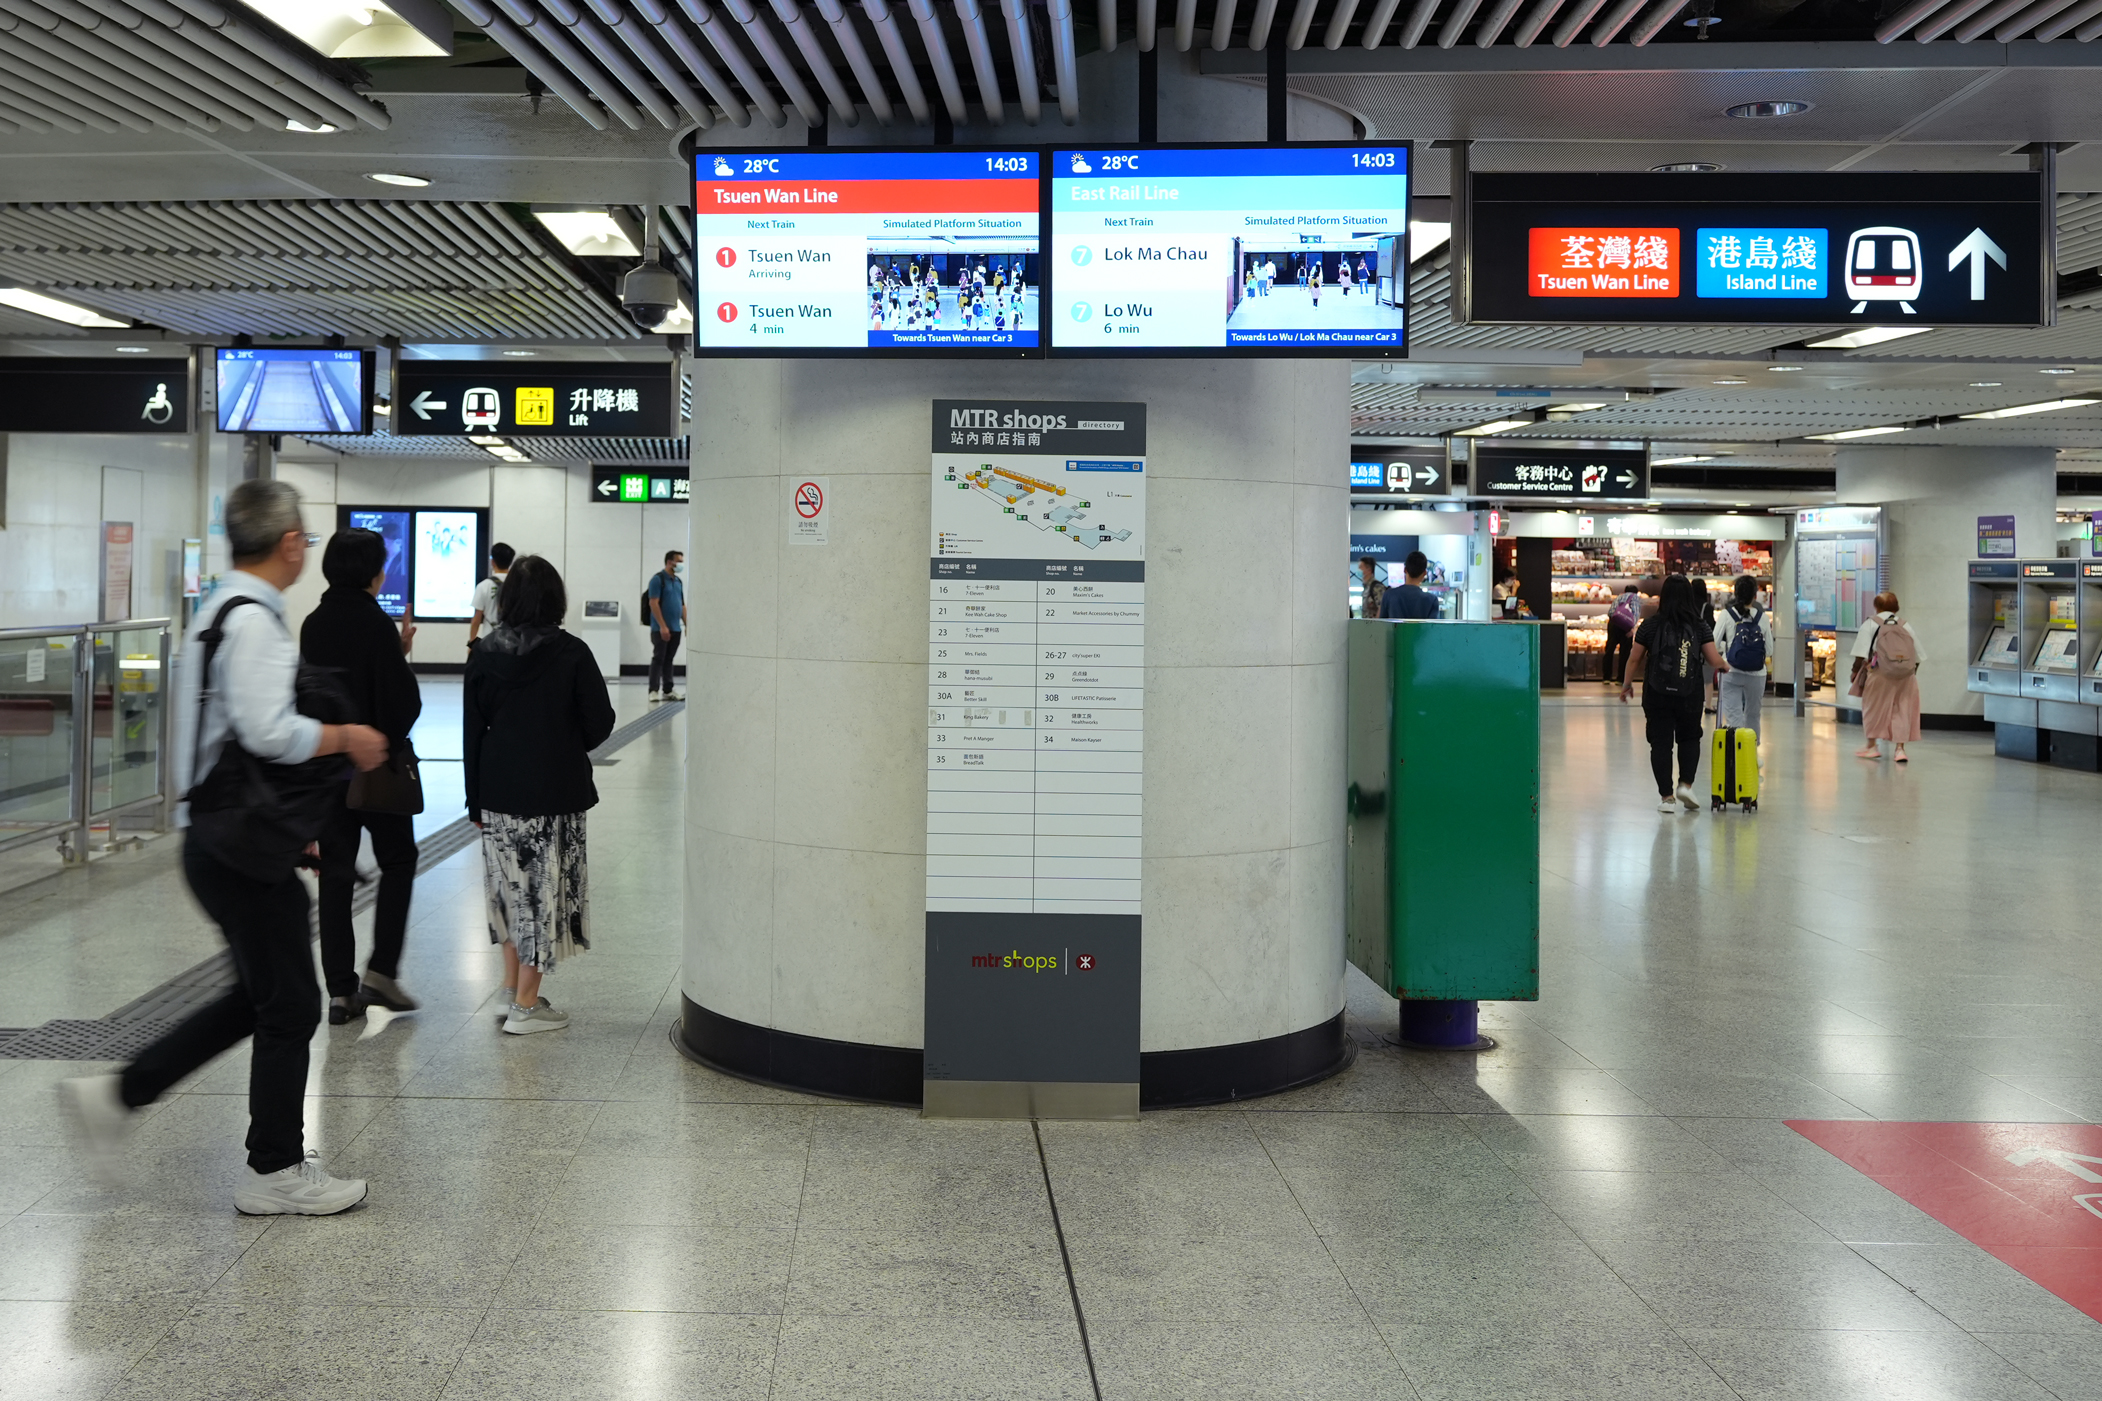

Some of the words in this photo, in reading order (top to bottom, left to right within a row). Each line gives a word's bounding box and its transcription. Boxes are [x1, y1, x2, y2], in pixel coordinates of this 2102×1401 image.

[743, 158, 779, 173] 28°C
[985, 157, 1028, 172] 14:03
[1101, 155, 1139, 170] 28°C
[1351, 153, 1395, 168] 14:03
[714, 188, 761, 203] Tsuen
[764, 188, 800, 203] Wan
[804, 187, 838, 203] Line
[1071, 186, 1105, 201] East
[1109, 185, 1139, 201] Rail
[1144, 185, 1179, 200] Line
[747, 220, 770, 229] Next
[772, 220, 795, 229] Train
[883, 218, 931, 229] Simulated
[934, 218, 976, 229] Platform
[978, 218, 1022, 229] Situation
[1104, 217, 1127, 227] Next
[1129, 217, 1154, 227] Train
[1244, 215, 1295, 226] Simulated
[1297, 215, 1340, 226] Platform
[1342, 215, 1388, 226] Situation
[722, 249, 730, 265] 1
[749, 249, 794, 263] Tsuen
[797, 249, 831, 263] Wan
[1076, 249, 1087, 263] 7
[1104, 246, 1134, 261] Lok
[1137, 247, 1162, 261] Ma
[1167, 246, 1208, 260] Chau
[1560, 235, 1669, 270] 荃灣綫
[1707, 235, 1817, 270] 港島綫
[749, 268, 791, 280] Arriving
[1538, 274, 1588, 291] Tsuen
[1591, 274, 1630, 291] Wan
[1634, 273, 1669, 291] Line
[1726, 273, 1779, 291] Island
[1781, 273, 1817, 291] Line
[724, 305, 731, 320] 1
[750, 305, 795, 318] Tsuen
[798, 305, 832, 318] Wan
[1076, 304, 1087, 319] 7
[1104, 303, 1123, 317] Lo
[1126, 304, 1153, 317] Wu
[749, 324, 758, 334] 4
[764, 324, 784, 334] min
[1104, 323, 1112, 334] 6
[1118, 323, 1140, 334] min
[893, 333, 926, 343] Towards
[927, 333, 951, 343] Tsuen
[952, 333, 970, 343] Wan
[972, 334, 989, 343] near
[991, 333, 1006, 343] Car
[1007, 333, 1013, 343] 3
[1231, 332, 1266, 342] Towards
[1268, 332, 1277, 342] Lo
[1278, 332, 1293, 342] Wu
[1294, 332, 1299, 342] /
[1300, 332, 1315, 342] Lok
[1316, 332, 1330, 342] Ma
[1331, 332, 1353, 342] Chau
[1355, 333, 1373, 342] near
[1375, 332, 1390, 342] Car
[1391, 332, 1397, 342] 3
[334, 352, 353, 360] 14:03
[569, 387, 639, 413] 升降機
[569, 414, 588, 427] Lift
[950, 408, 999, 428] MTR
[1003, 408, 1067, 433] shops
[1082, 421, 1120, 429] directory
[950, 431, 1041, 446] 站內商店指南
[1514, 464, 1573, 481] 客務中心
[1351, 477, 1368, 485] Island
[1368, 477, 1380, 485] Line
[1487, 481, 1522, 490] Customer
[1522, 482, 1548, 491] Service
[1549, 482, 1573, 491] Centre
[655, 481, 667, 495] A
[1365, 543, 1387, 553] cakes
[939, 586, 949, 594] 16
[1045, 587, 1056, 595] 20
[938, 607, 947, 615] 21
[1045, 609, 1055, 617] 22
[938, 628, 948, 636] 23
[938, 649, 947, 657] 25
[1045, 651, 1067, 659] 26-27
[1678, 638, 1691, 678] Supreme
[937, 671, 947, 679] 28
[1045, 672, 1055, 680] 29
[937, 692, 952, 700] 30A
[1044, 694, 1059, 702] 30B
[936, 713, 945, 721] 31
[936, 734, 946, 742] 33
[936, 755, 946, 763] 35
